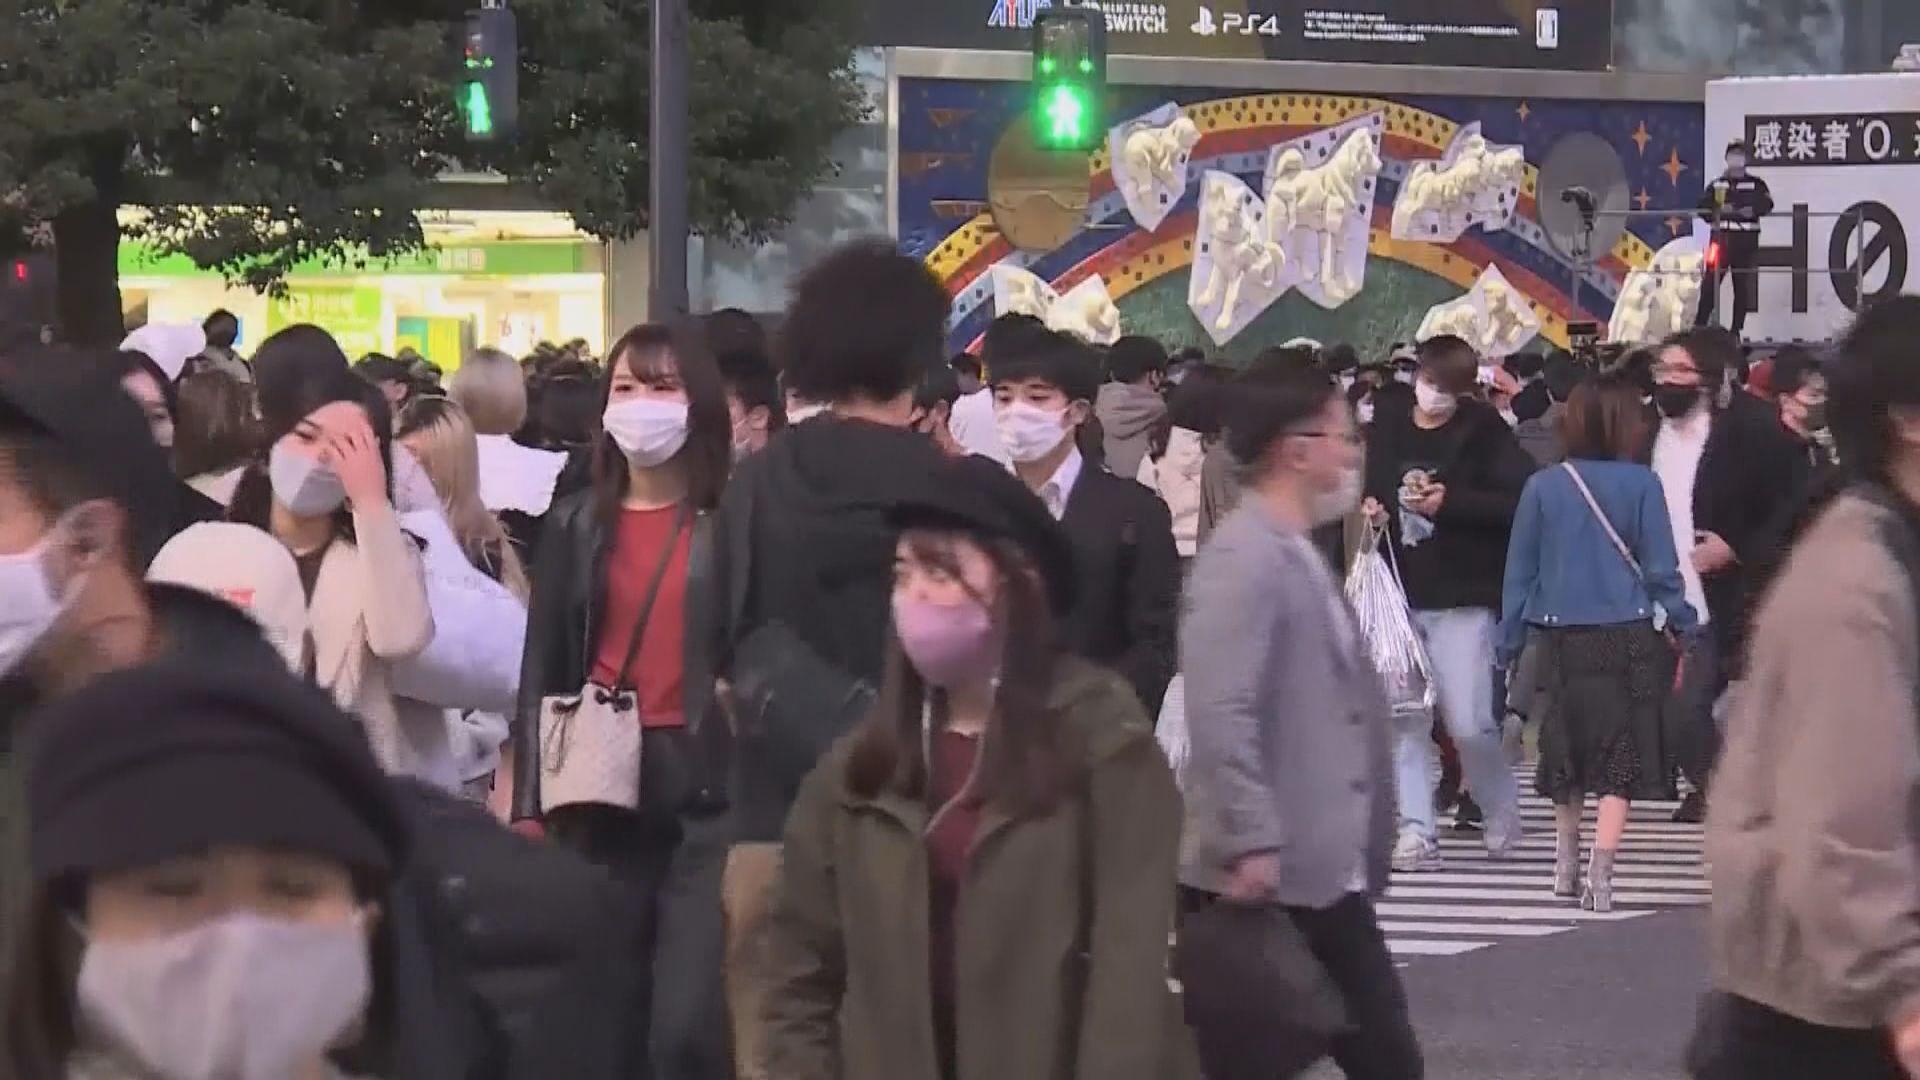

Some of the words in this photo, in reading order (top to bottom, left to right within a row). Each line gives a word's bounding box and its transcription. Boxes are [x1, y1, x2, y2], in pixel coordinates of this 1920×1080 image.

[1103, 3, 1166, 14] NINTENDO
[1104, 13, 1168, 33] SWITCH
[1223, 12, 1281, 36] PS4
